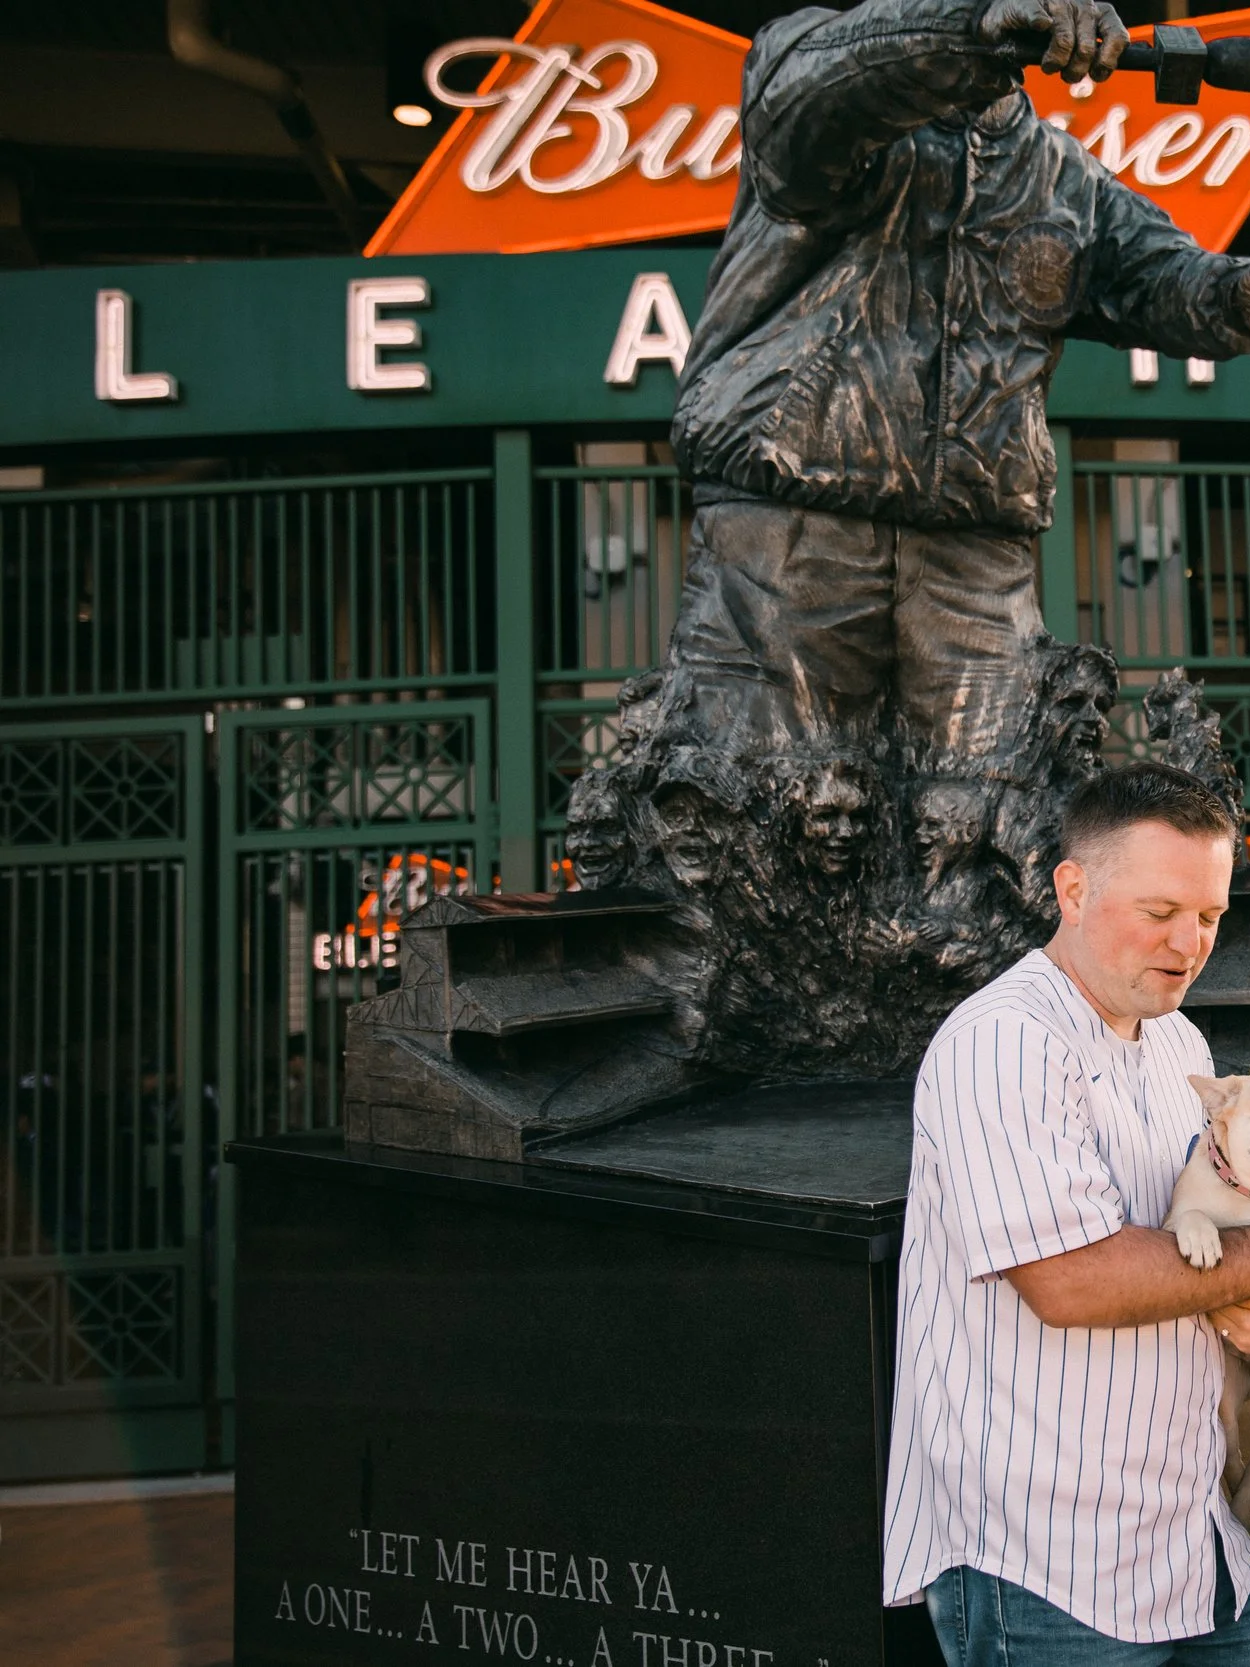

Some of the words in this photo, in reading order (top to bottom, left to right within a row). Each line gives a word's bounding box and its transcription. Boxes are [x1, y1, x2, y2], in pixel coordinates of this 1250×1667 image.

[350, 1529, 420, 1577] “LET
[435, 1538, 488, 1587] ME
[506, 1547, 612, 1605] HEAR
[274, 1579, 297, 1621] A
[415, 1600, 439, 1645] A
[591, 1626, 613, 1667] A
